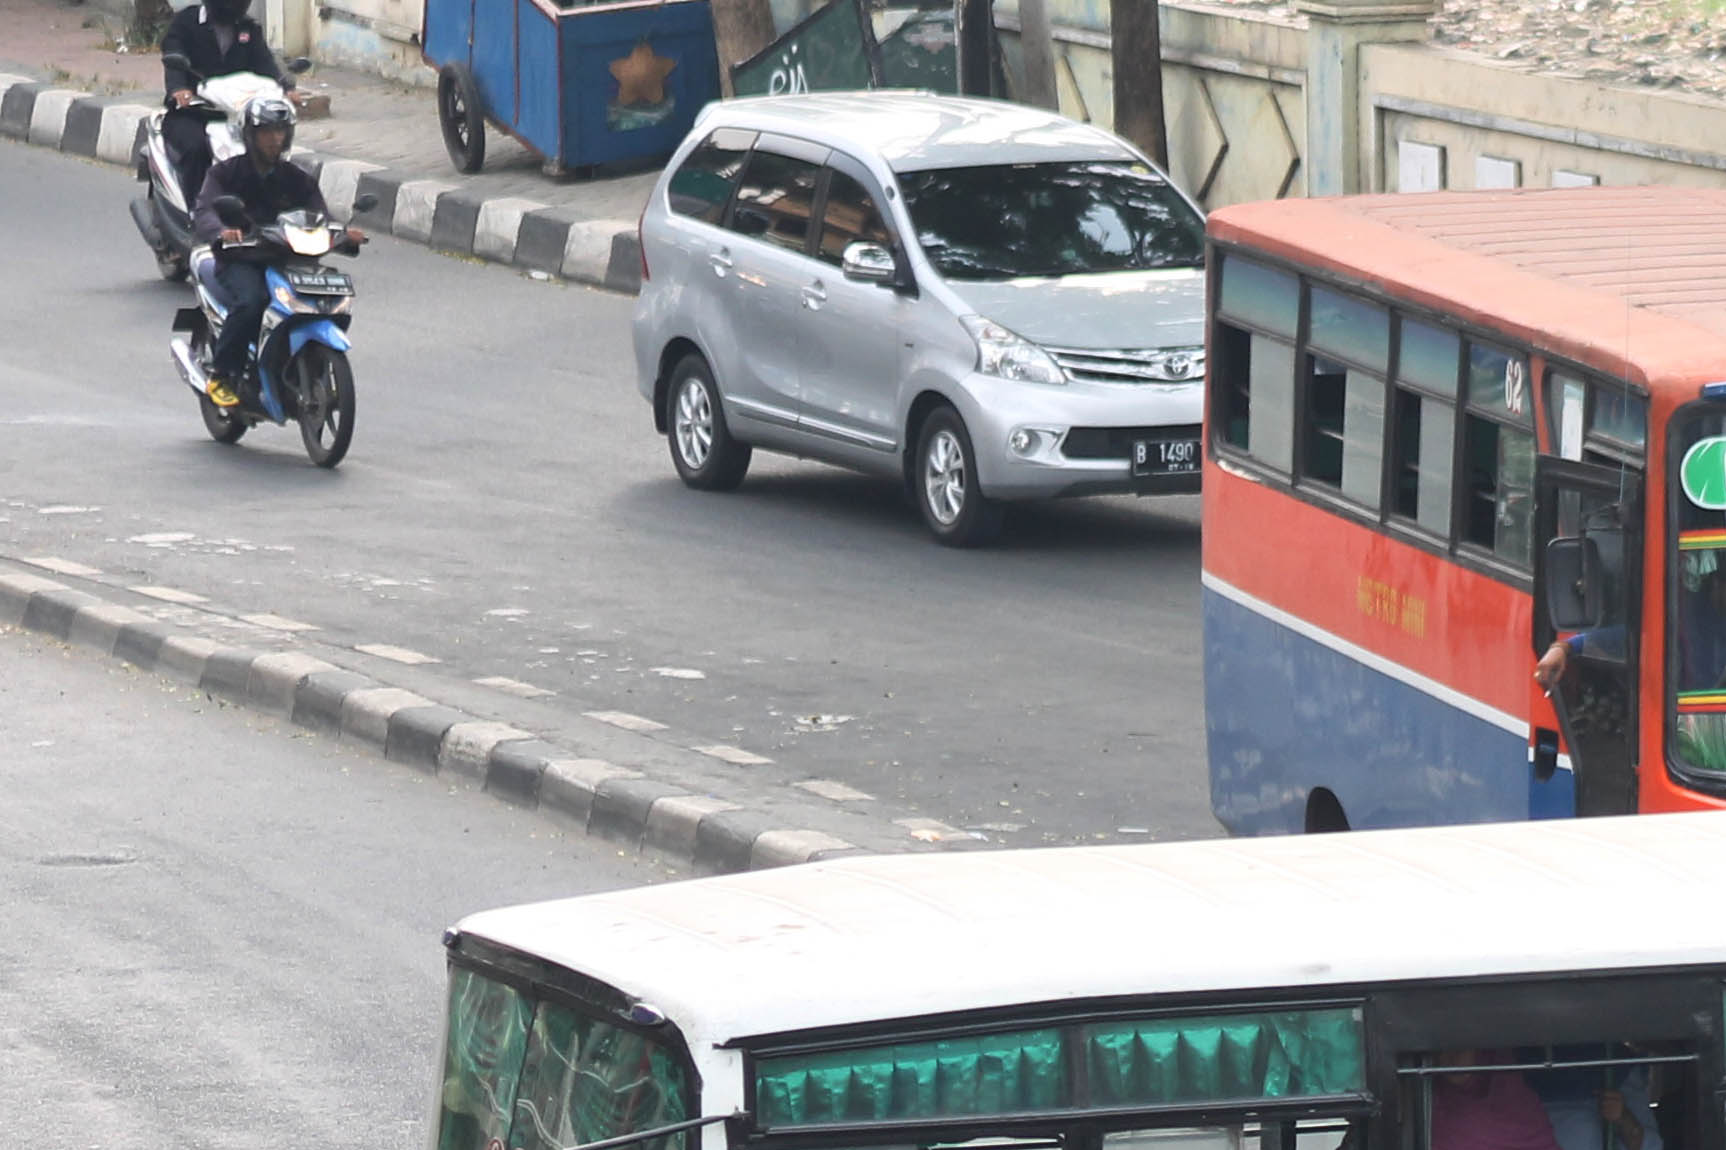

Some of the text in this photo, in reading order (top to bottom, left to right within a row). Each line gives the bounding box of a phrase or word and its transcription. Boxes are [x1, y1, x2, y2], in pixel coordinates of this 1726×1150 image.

[1505, 359, 1522, 413] 62
[1136, 442, 1194, 464] B 1490
